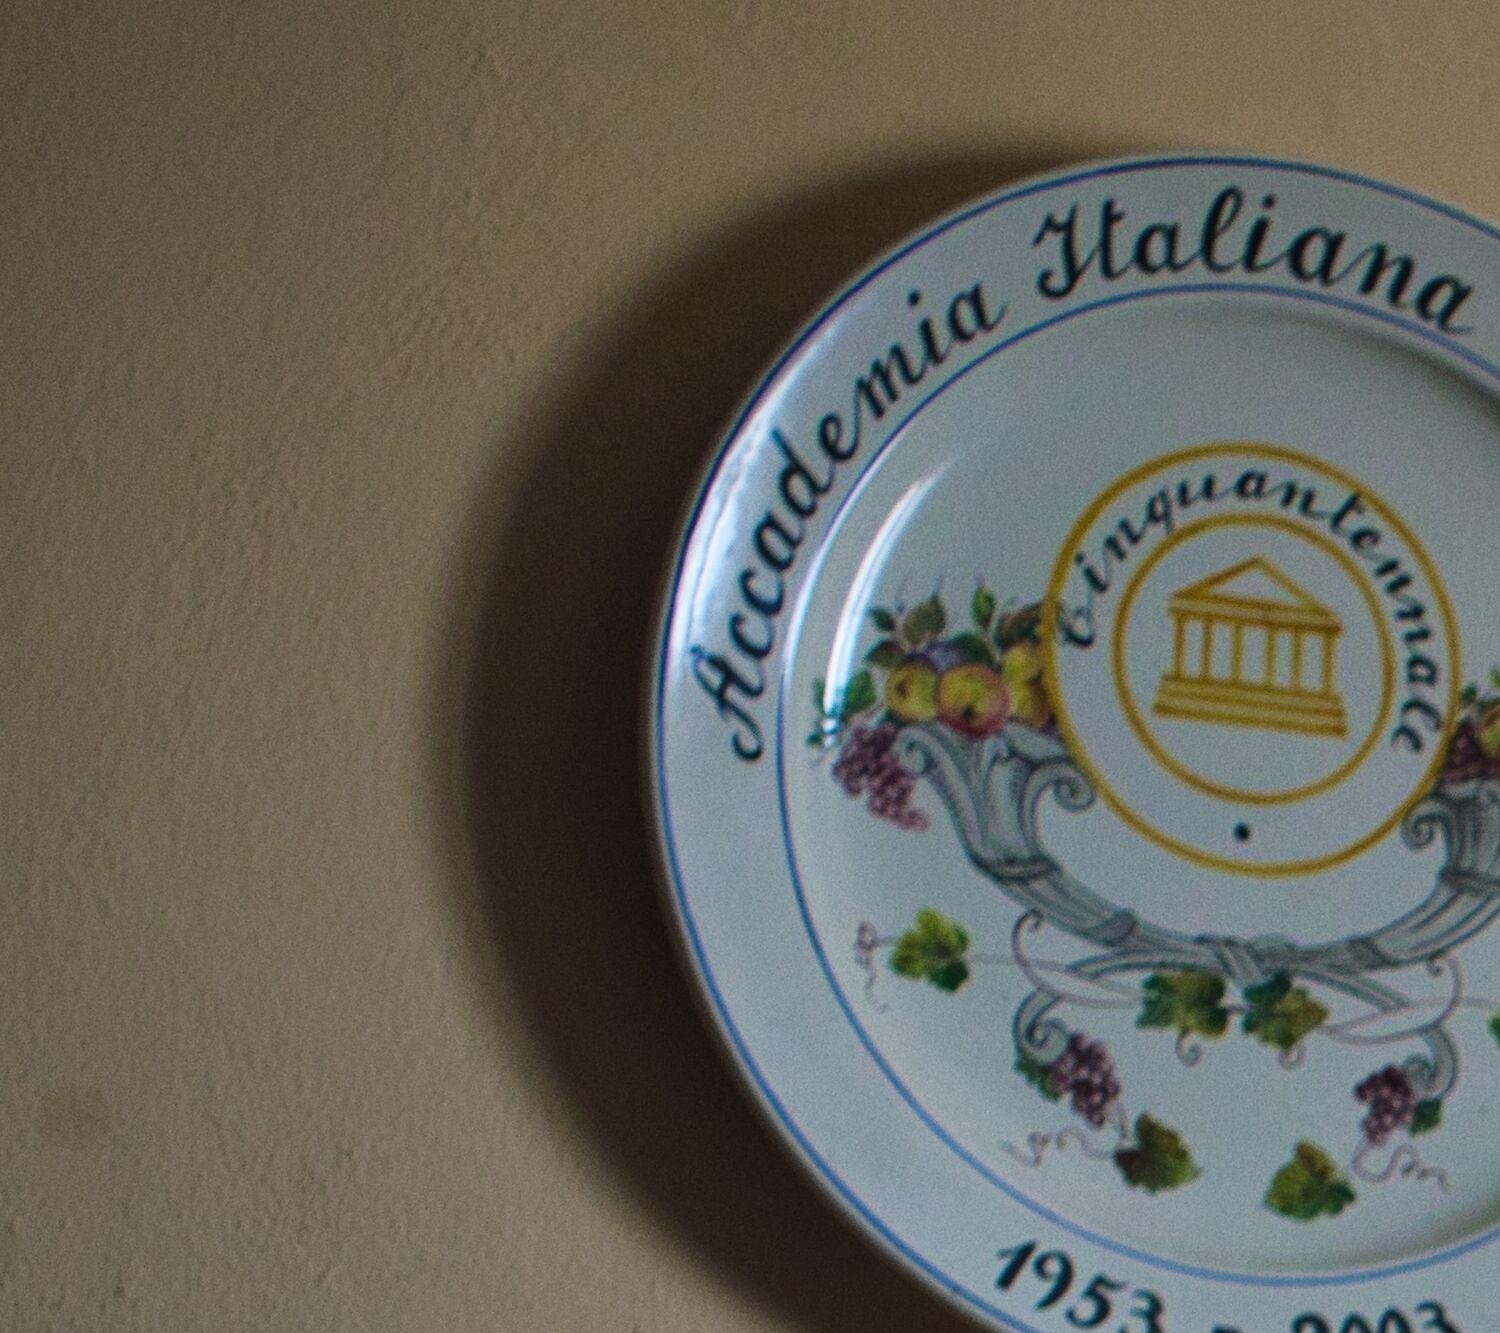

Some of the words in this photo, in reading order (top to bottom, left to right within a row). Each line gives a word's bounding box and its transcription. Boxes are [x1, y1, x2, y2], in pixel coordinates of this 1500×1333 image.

[690, 282, 1012, 763] Accademia
[1036, 186, 1475, 338] Italiana
[1060, 467, 1442, 752] Cinquantennale
